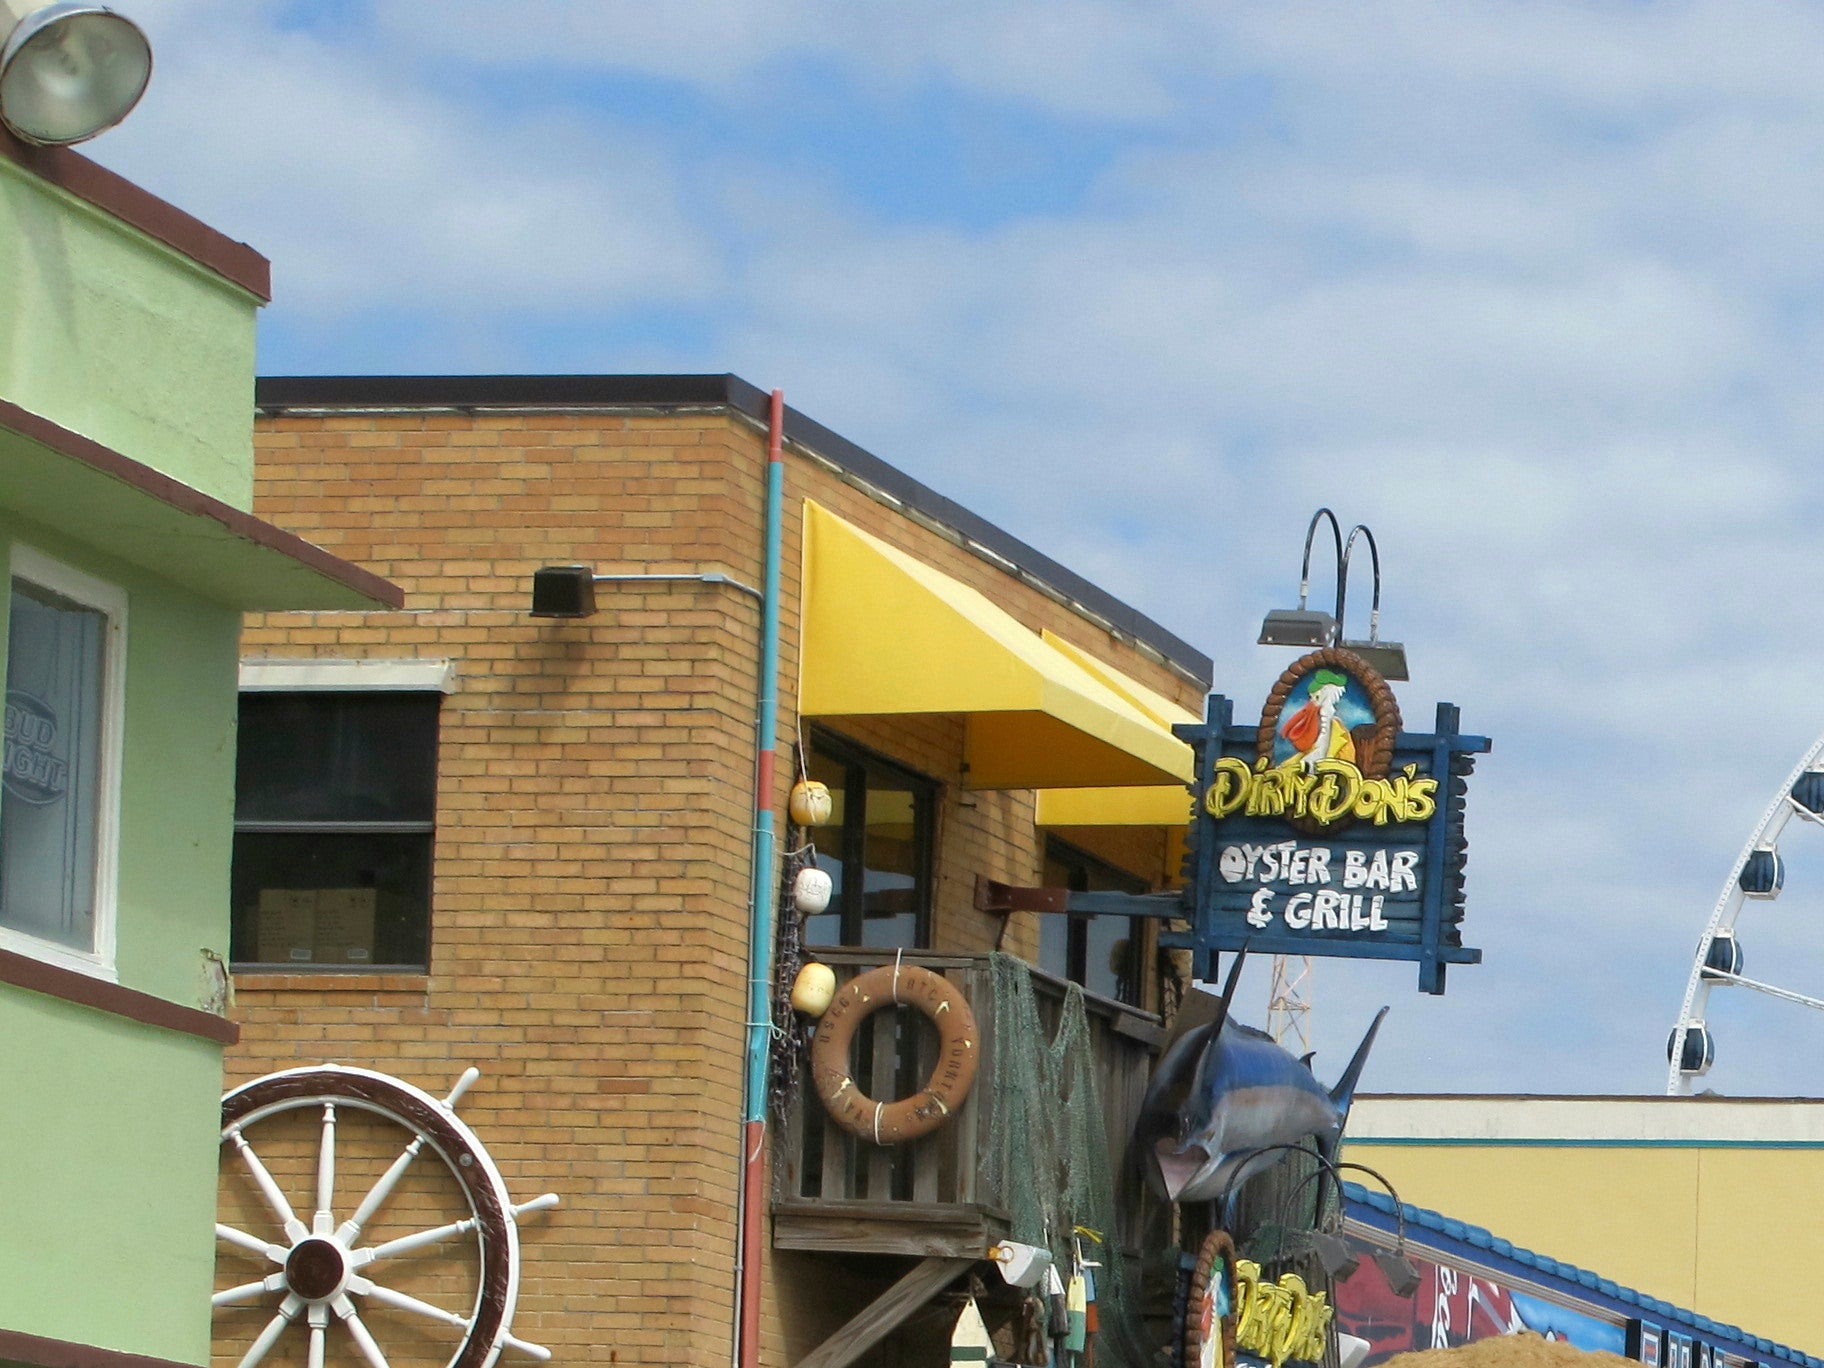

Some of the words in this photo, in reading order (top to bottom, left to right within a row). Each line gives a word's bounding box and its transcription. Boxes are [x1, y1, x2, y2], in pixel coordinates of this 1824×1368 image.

[6, 742, 69, 791] IGHT
[1219, 840, 1331, 886] OYSTER
[1343, 849, 1419, 893] BAR
[1247, 887, 1276, 929] &
[1284, 889, 1388, 932] GRILL
